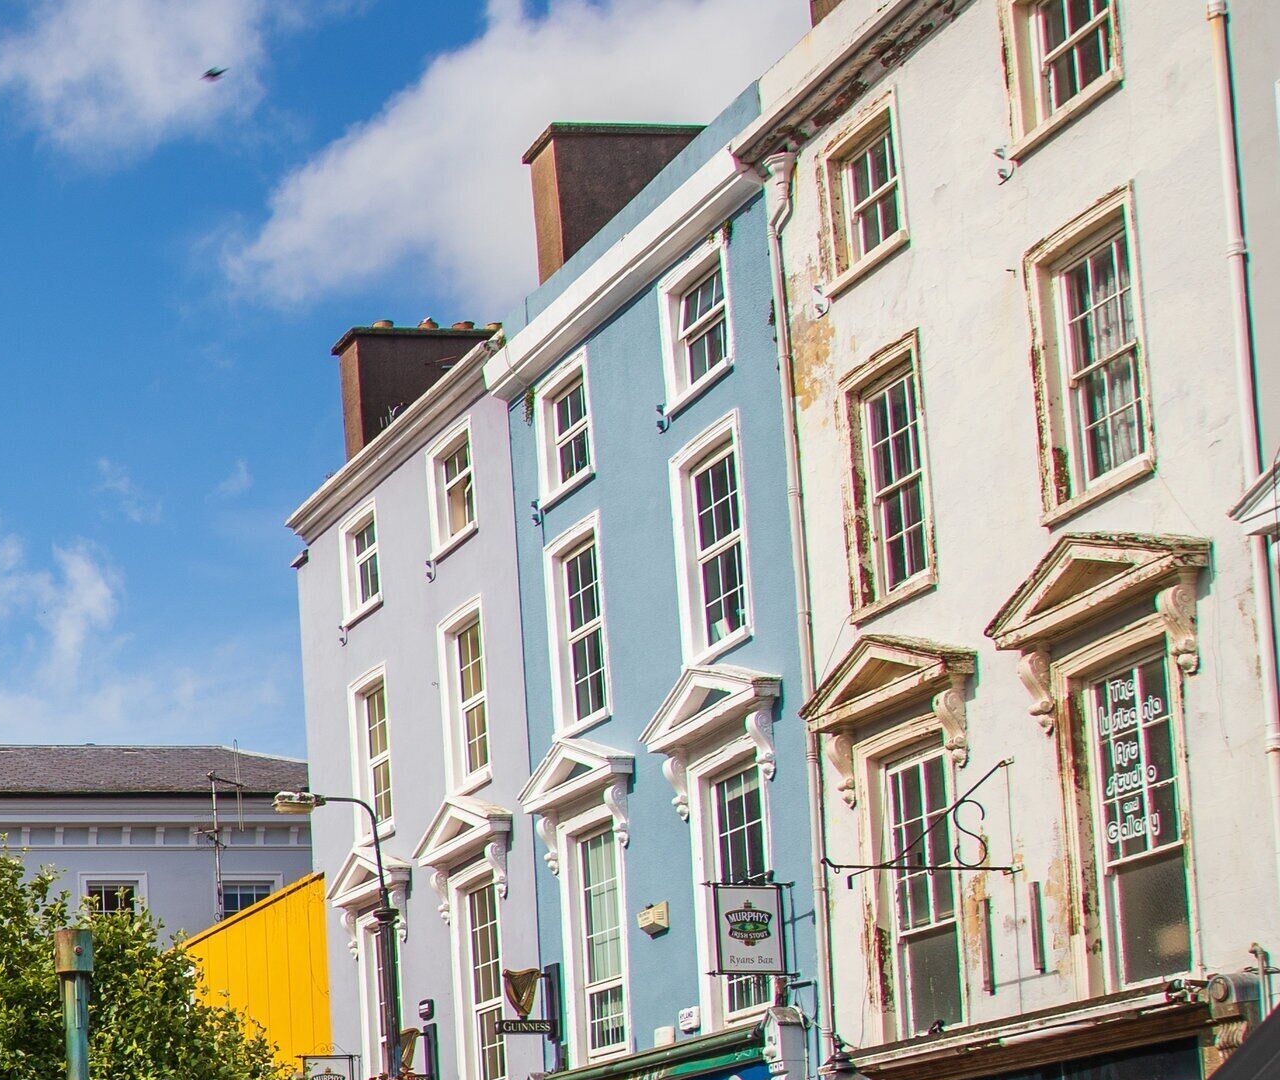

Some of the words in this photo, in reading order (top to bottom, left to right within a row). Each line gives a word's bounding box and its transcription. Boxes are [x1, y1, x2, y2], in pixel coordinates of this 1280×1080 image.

[1110, 679, 1134, 702] The
[1114, 741, 1138, 766] Art
[1106, 765, 1157, 796] studo
[1123, 797, 1139, 813] and
[731, 931, 749, 939] IRISH
[748, 930, 769, 939] STOUT
[729, 955, 755, 967] Ryans
[757, 955, 774, 965] Bar
[503, 1021, 551, 1032] GUINNESS
